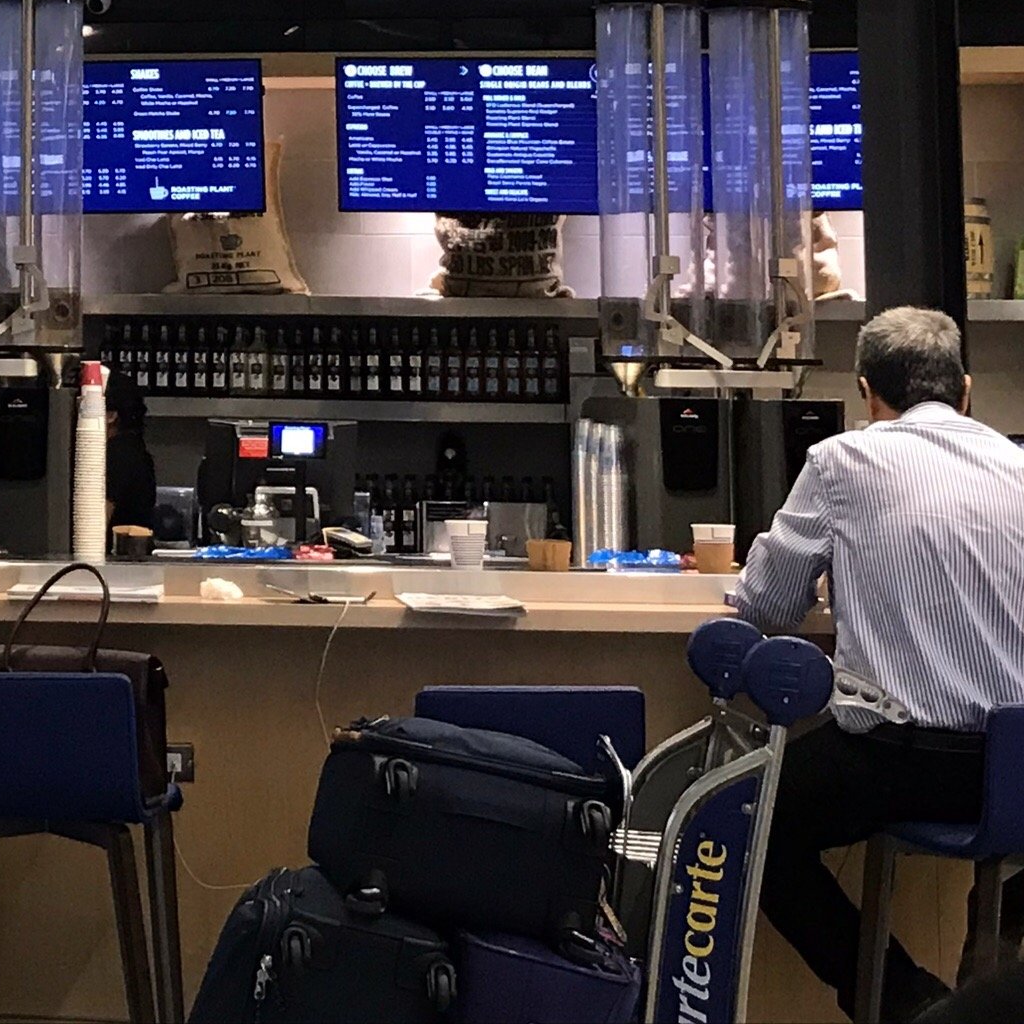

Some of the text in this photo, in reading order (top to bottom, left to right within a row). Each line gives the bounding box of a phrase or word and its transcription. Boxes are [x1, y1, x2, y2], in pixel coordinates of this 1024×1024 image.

[130, 69, 159, 80] SHAKES
[493, 65, 523, 76] CHOOSE
[211, 129, 224, 139] TEA
